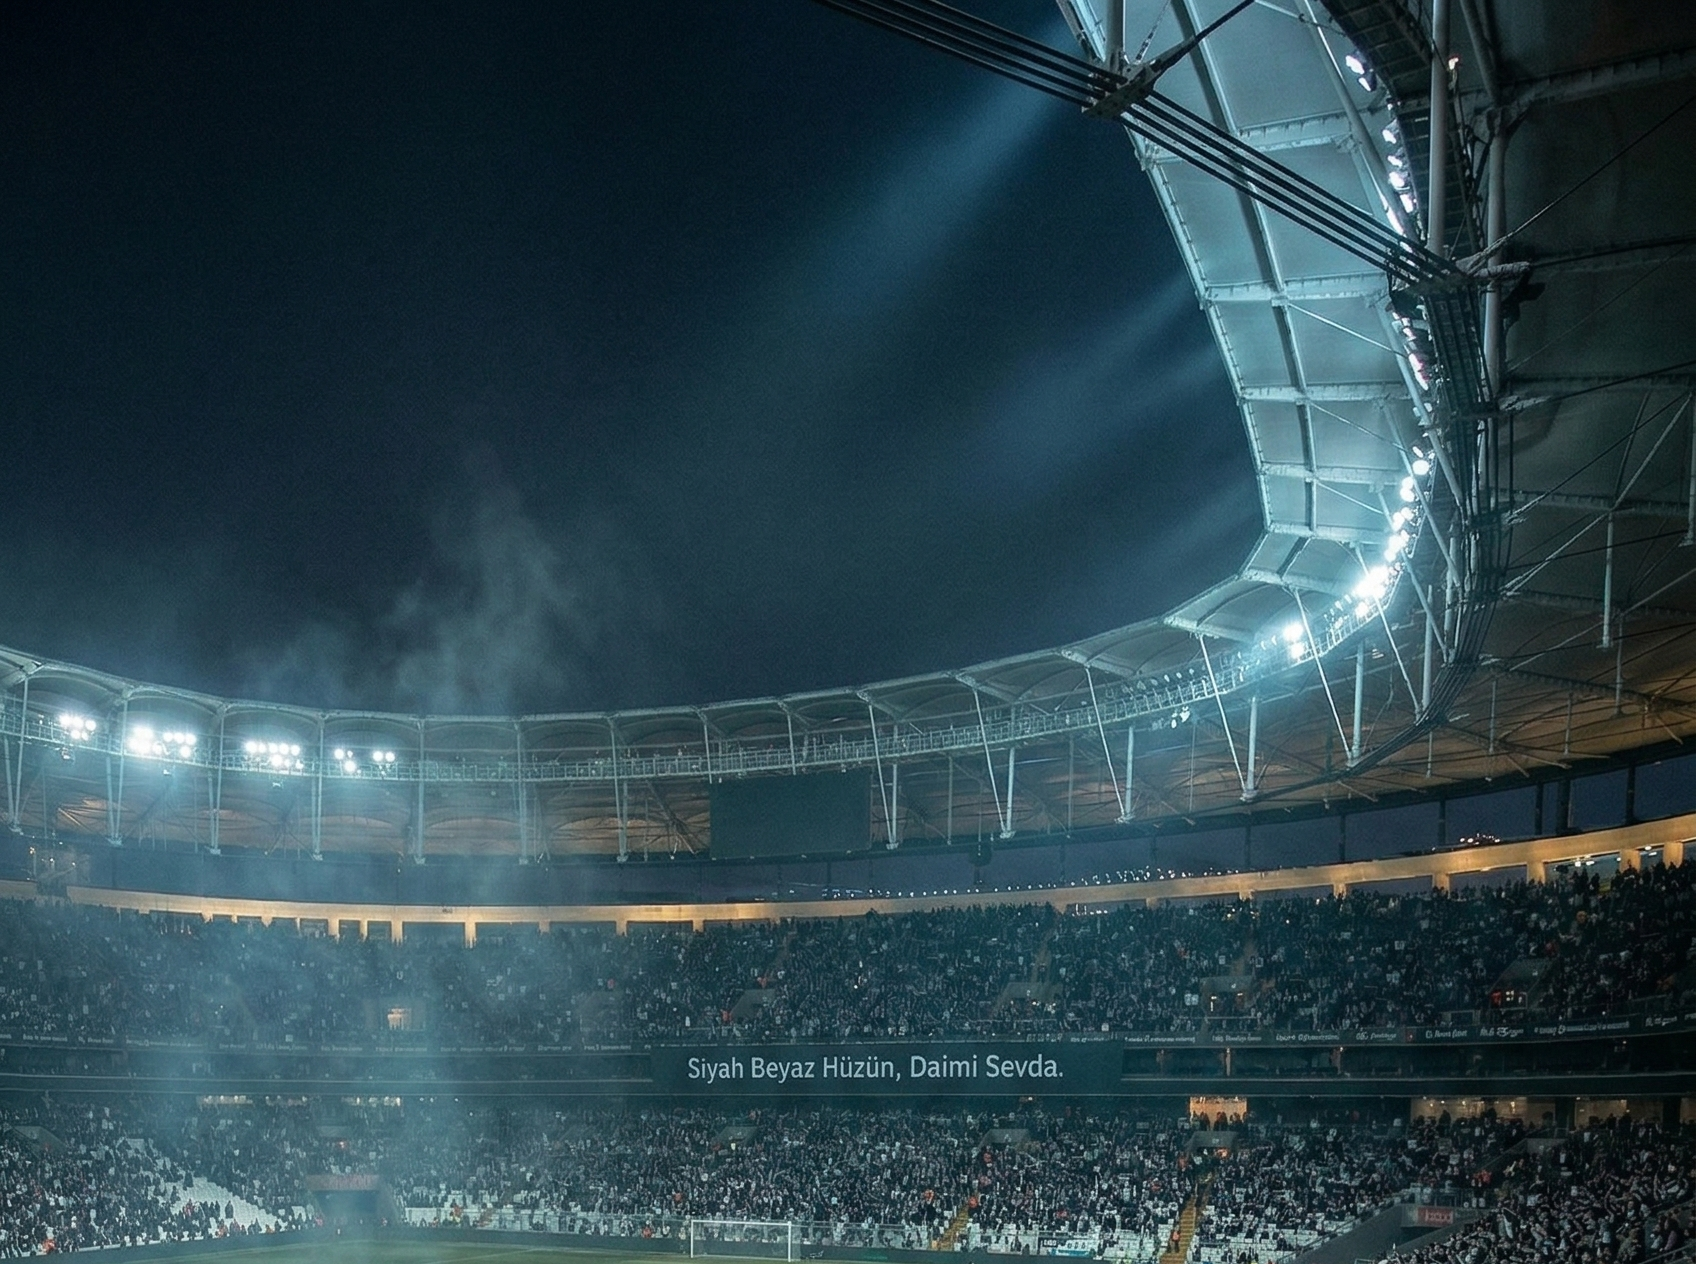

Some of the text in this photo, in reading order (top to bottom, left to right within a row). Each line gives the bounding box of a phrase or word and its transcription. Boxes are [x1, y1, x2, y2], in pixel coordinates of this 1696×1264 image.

[687, 1053, 1064, 1085] Siyah Beyaz Hüzün, Daimi Sevda.
